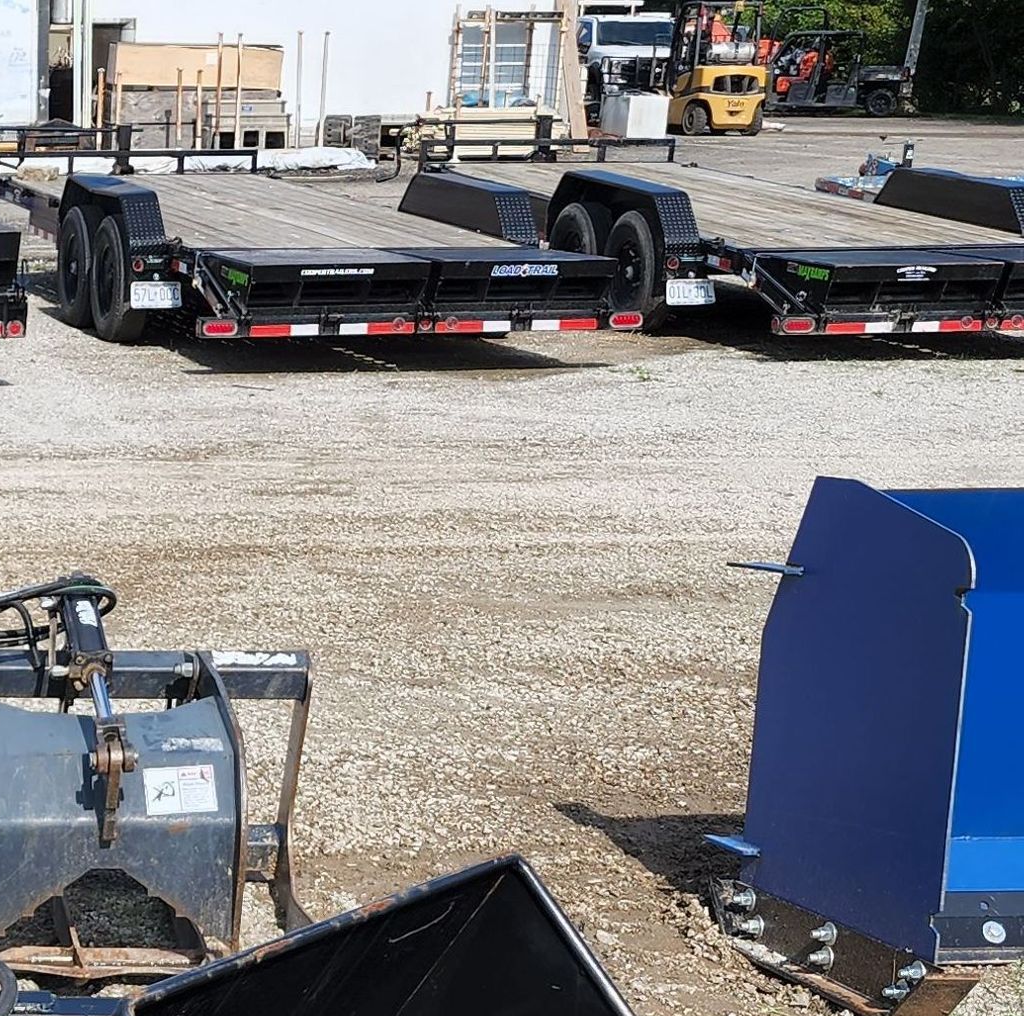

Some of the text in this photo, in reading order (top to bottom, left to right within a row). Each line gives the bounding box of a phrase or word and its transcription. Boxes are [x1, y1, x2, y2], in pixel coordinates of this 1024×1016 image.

[491, 264, 558, 276] LOAD TRAIL
[134, 287, 155, 302] 57L
